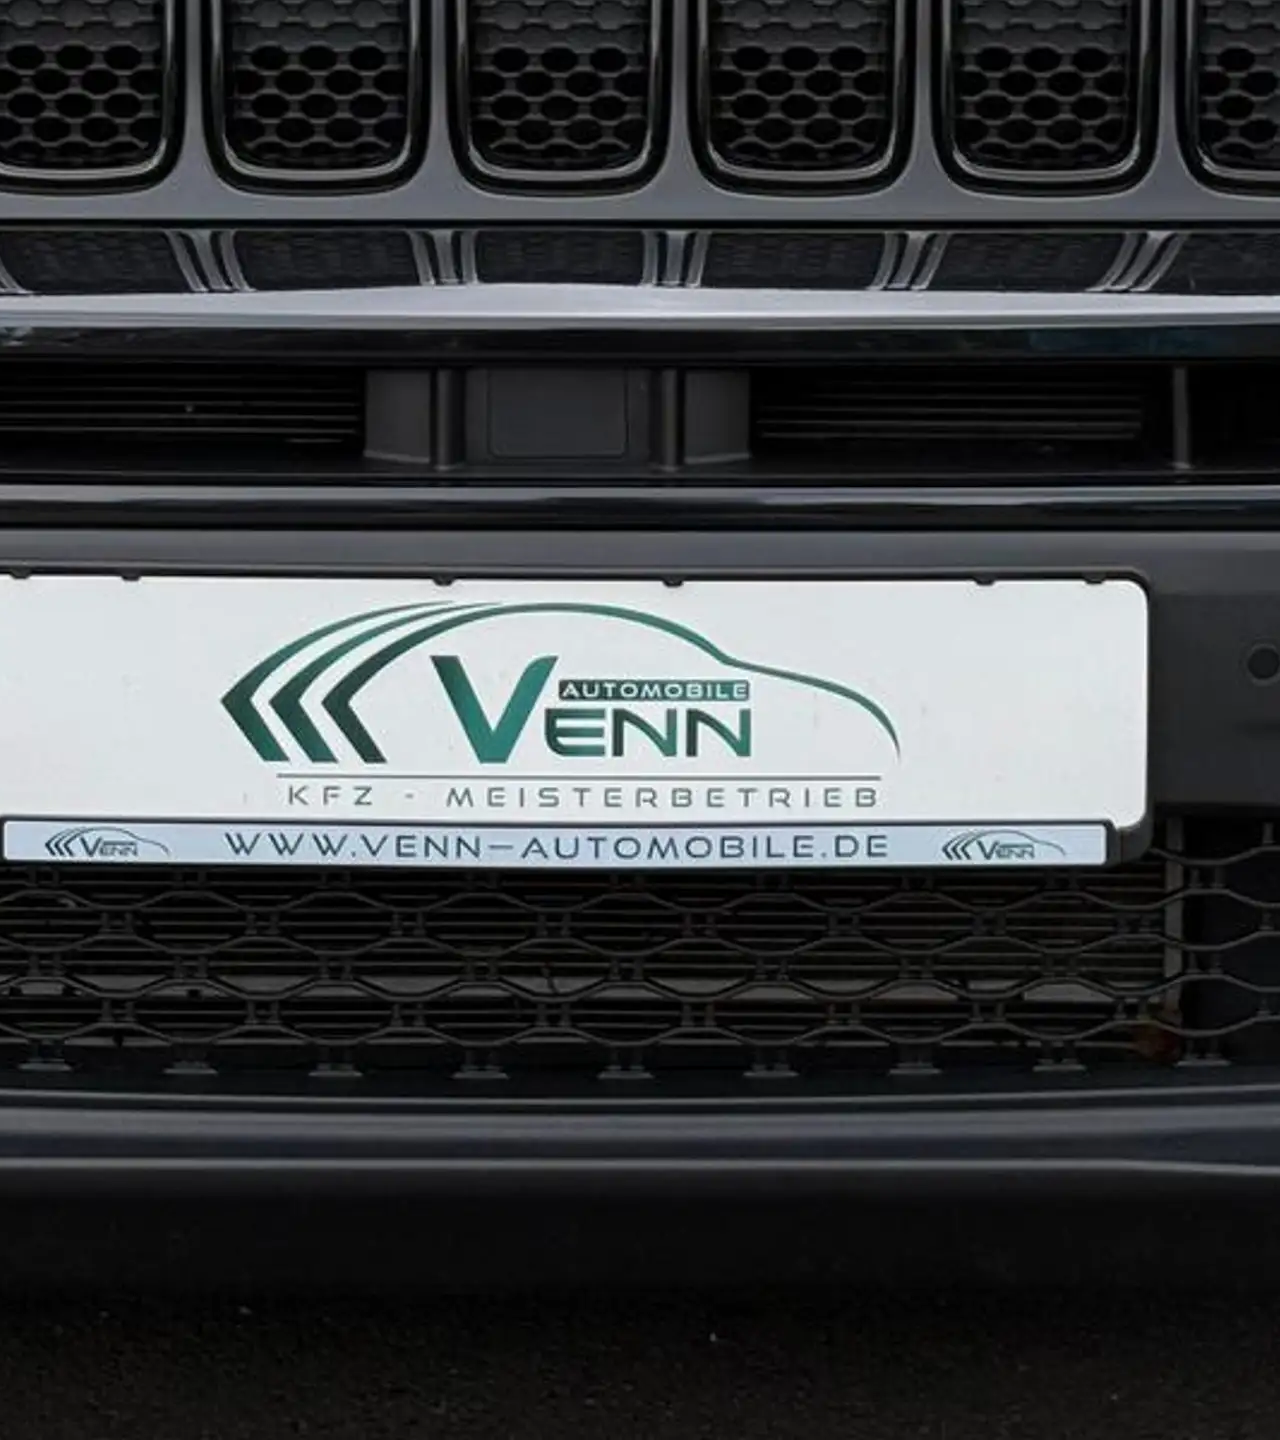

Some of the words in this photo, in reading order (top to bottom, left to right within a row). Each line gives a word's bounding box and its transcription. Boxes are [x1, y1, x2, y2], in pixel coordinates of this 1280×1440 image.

[560, 681, 748, 700] AUTOMOBILE
[430, 655, 752, 764] VENN
[287, 785, 373, 807] KFZ
[445, 786, 878, 809] MEISTERBETRIEB
[224, 832, 889, 860] WWW.VENN-AUTOMOBILE.DE
